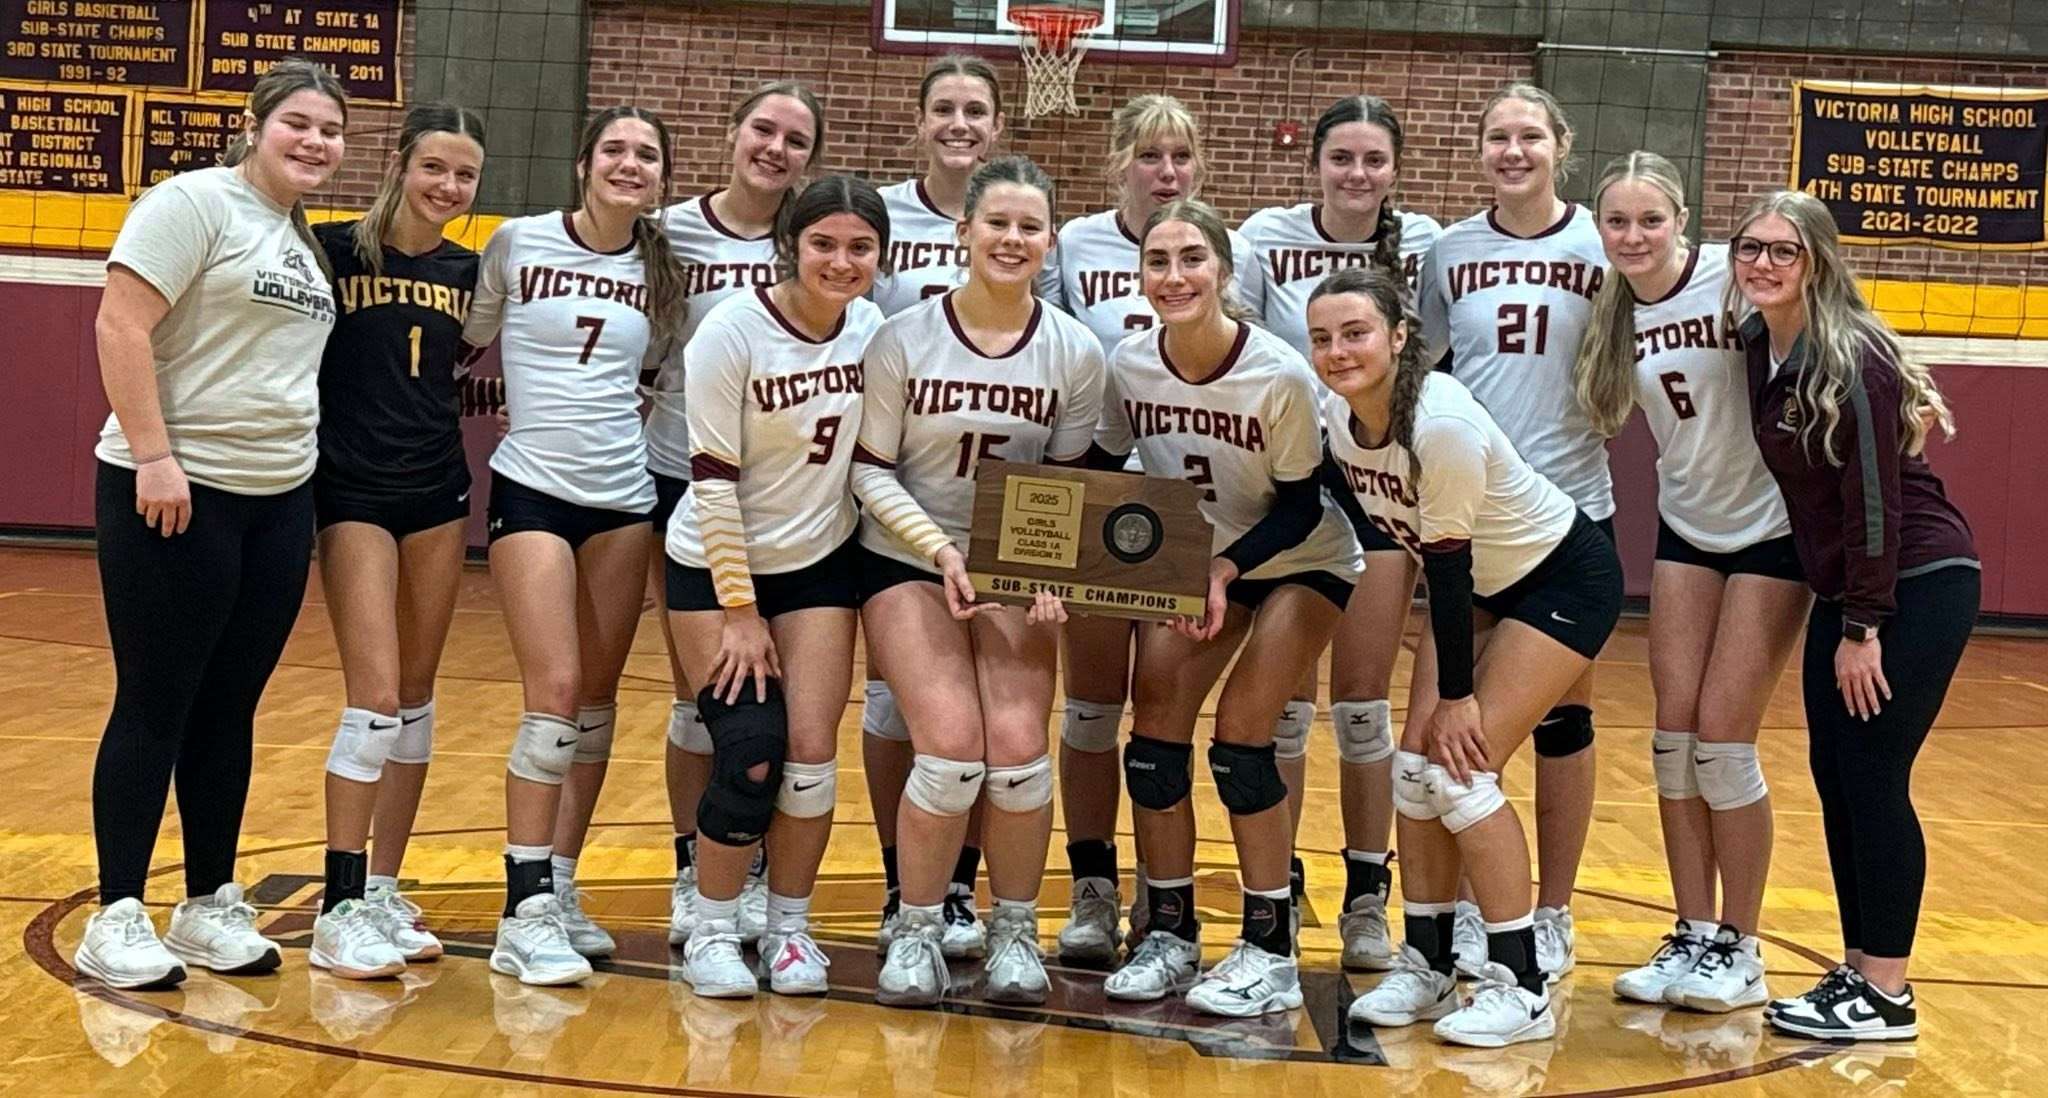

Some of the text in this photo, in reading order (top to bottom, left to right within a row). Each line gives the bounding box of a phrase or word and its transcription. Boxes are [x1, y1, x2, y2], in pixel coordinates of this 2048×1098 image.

[27, 0, 160, 21] GIRLS BASKETBALL
[247, 4, 379, 29] 4TH AT STATE 1A
[20, 21, 101, 39] SUB-STATE
[7, 42, 177, 63] 3RD STATE TOURNAMENT
[221, 32, 380, 54] SUB STATE CHAMPIONS
[212, 58, 247, 74] BOYS
[350, 65, 384, 81] 2011
[17, 97, 51, 112] HIGH
[64, 98, 120, 116] SCHOOL
[1814, 98, 2036, 128] VICTORIA HIGH SCHOOL
[11, 115, 101, 133] BASKETBALL
[32, 134, 95, 151] DISTRICT
[1865, 129, 1984, 155] VOLLEYBALL
[20, 152, 102, 169] REGIONALS
[1827, 153, 2019, 182] SUB-STATE CHAMPS
[1805, 178, 2039, 209] 4TH STATE TOURNAMENT
[1861, 210, 1979, 236] 2021-2022
[576, 315, 607, 365] 7
[1498, 304, 1549, 355] 21
[408, 325, 423, 377] 1
[1659, 371, 1697, 420] 6
[1124, 399, 1266, 453] VICTORIA
[806, 415, 842, 465] 9
[1010, 526, 1072, 541] VOLLEYBALL
[1017, 538, 1047, 549] CLASS
[991, 577, 1177, 610] SUB-STATE CHAMPIONS
